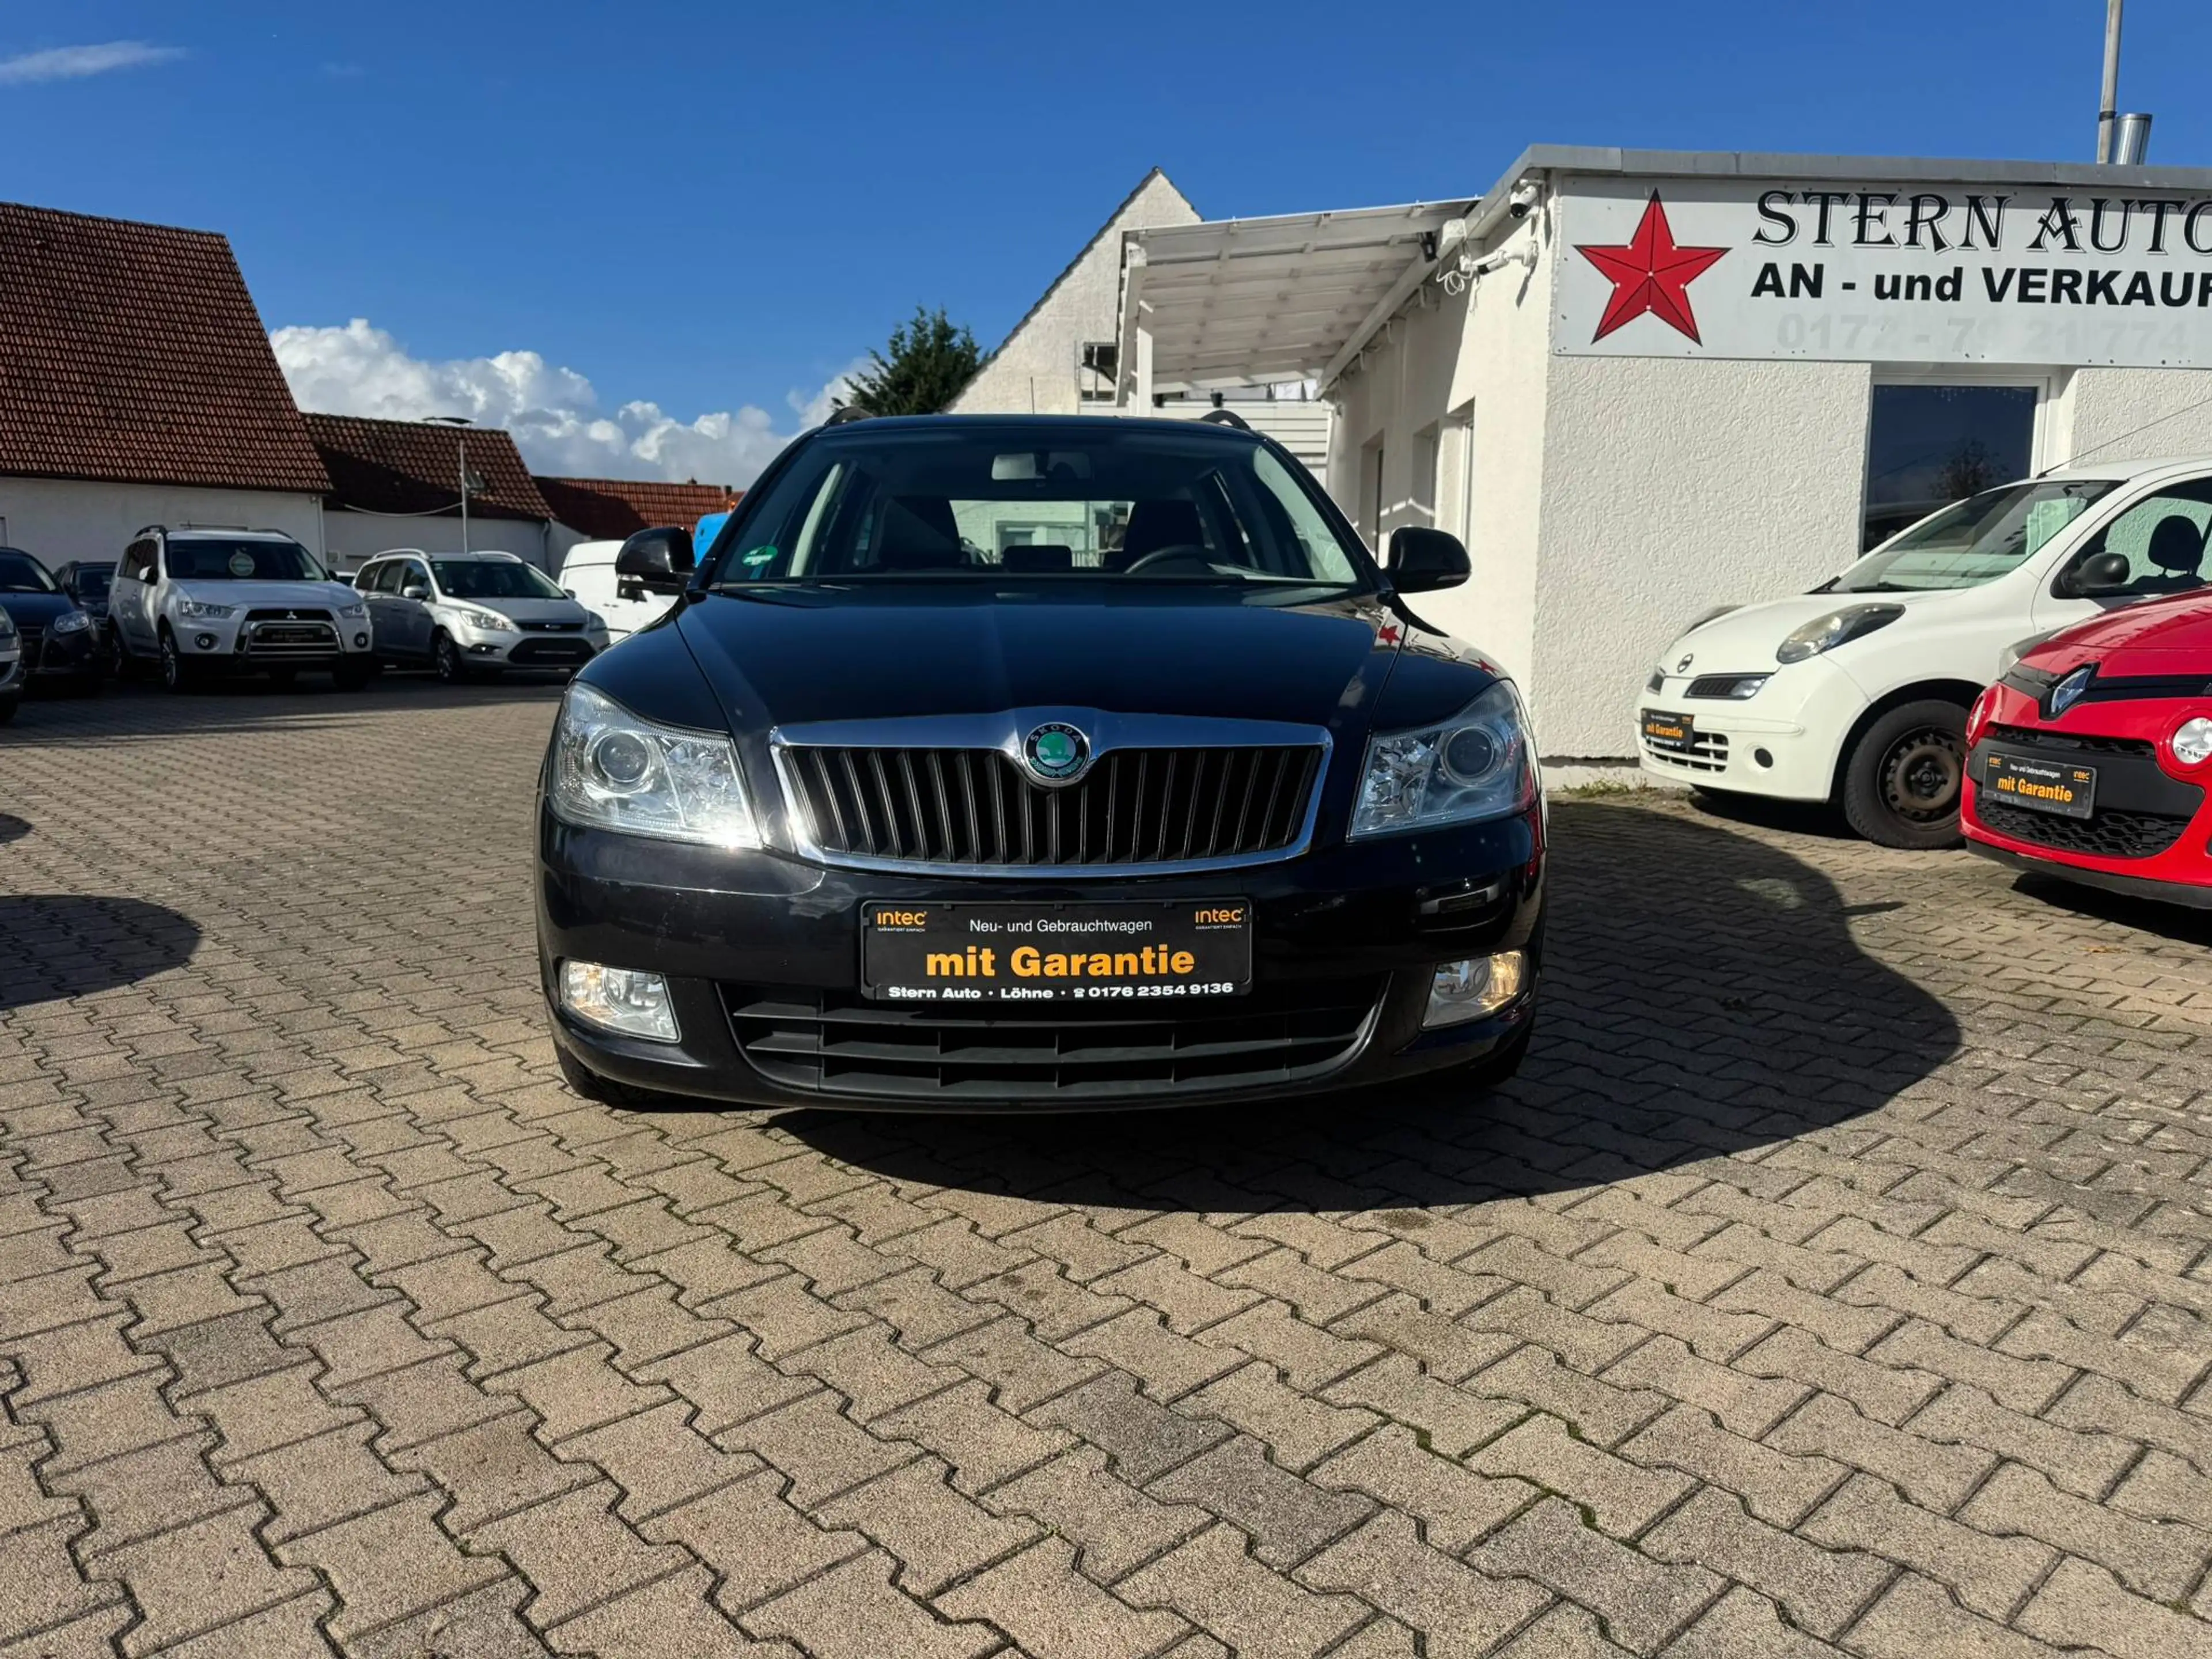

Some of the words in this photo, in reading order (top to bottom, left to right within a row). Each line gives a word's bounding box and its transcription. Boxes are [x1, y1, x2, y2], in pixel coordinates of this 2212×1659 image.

[1751, 190, 2012, 255] STERN
[1751, 263, 1824, 298] AN
[1874, 267, 1963, 301] und
[1998, 776, 2016, 791] mit
[2018, 778, 2073, 802] Garantie
[877, 911, 926, 925] intec
[1195, 908, 1243, 923] intec
[969, 919, 1003, 932] Neu-
[1007, 920, 1032, 932] und
[1036, 919, 1152, 934] Gebrauchtwagen
[926, 946, 995, 976] mit
[1010, 944, 1195, 977] Garantie
[888, 986, 937, 998] Stern
[942, 987, 982, 999] Auto
[1001, 987, 1054, 999] Löhne
[1088, 987, 1134, 997] 0176
[1137, 984, 1187, 997] 2354
[1189, 982, 1234, 994] 9136
